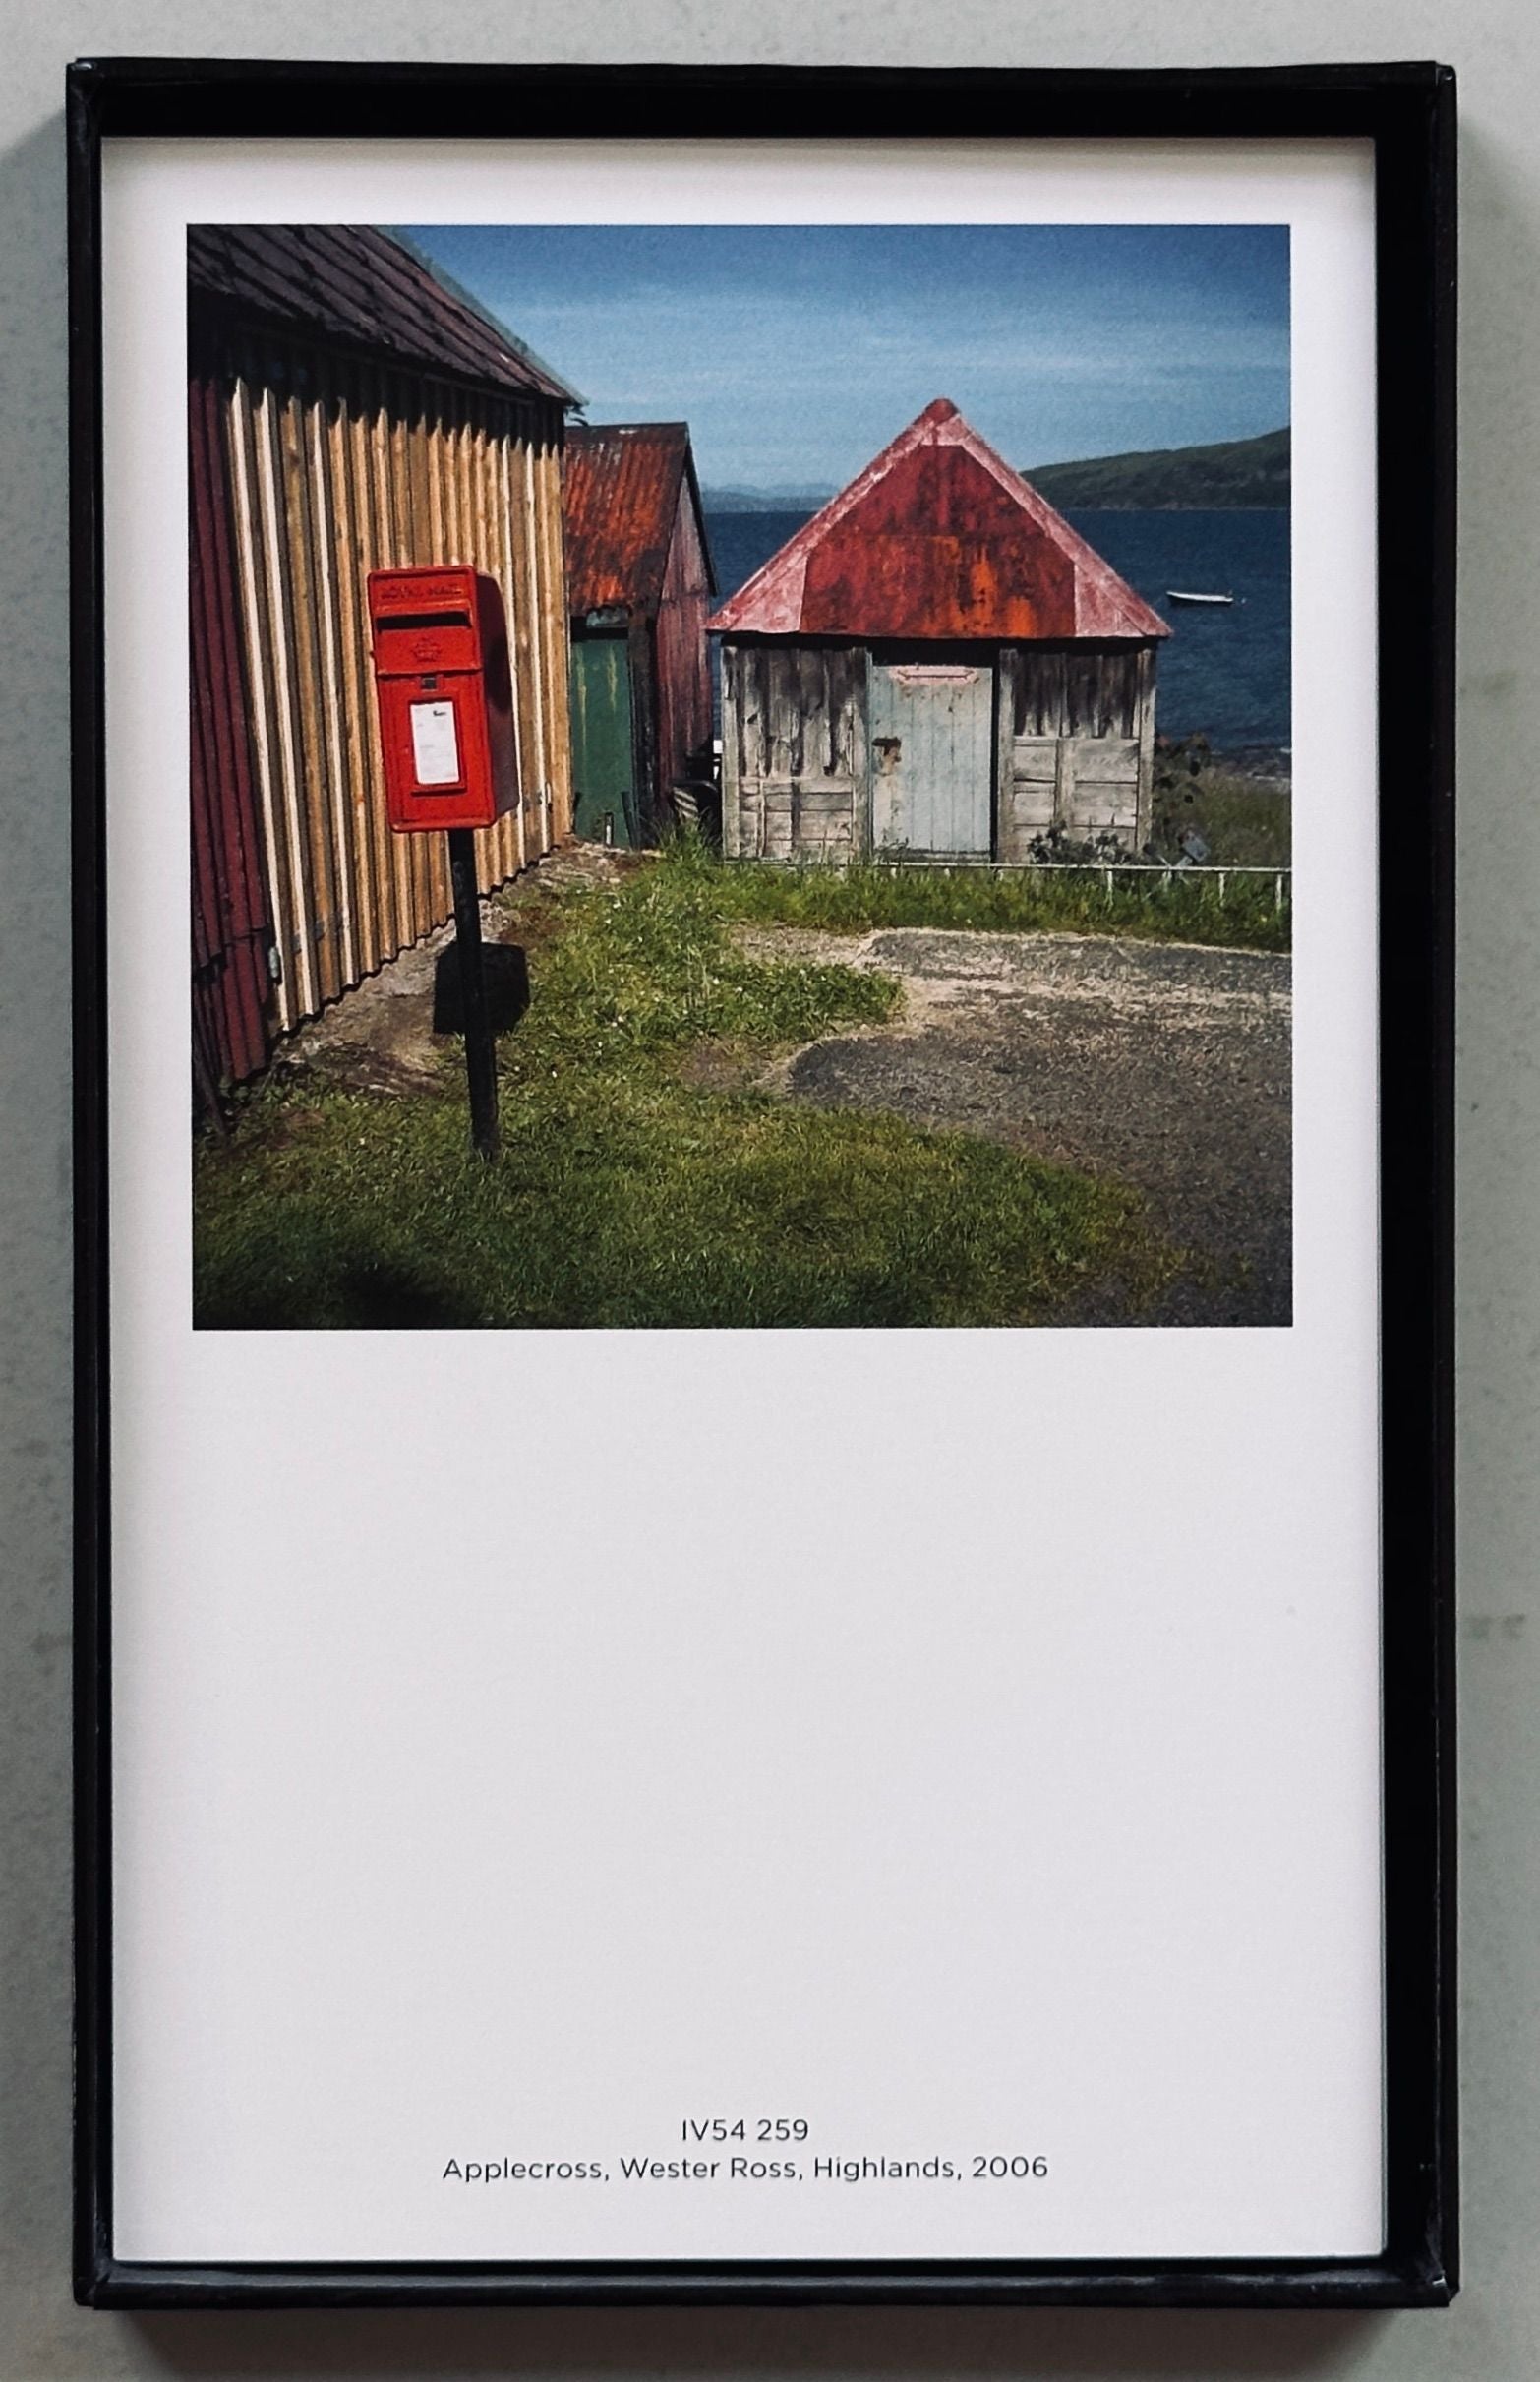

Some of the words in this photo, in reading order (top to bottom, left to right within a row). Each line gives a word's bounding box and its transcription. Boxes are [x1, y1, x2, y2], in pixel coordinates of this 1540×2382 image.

[683, 2119, 744, 2141] IV54
[758, 2119, 808, 2141] 259
[443, 2157, 609, 2183] Applecross,
[621, 2157, 720, 2178] Wester
[732, 2157, 802, 2181] Ross,
[815, 2157, 961, 2183] Highlands,
[973, 2157, 1048, 2178] 2006
